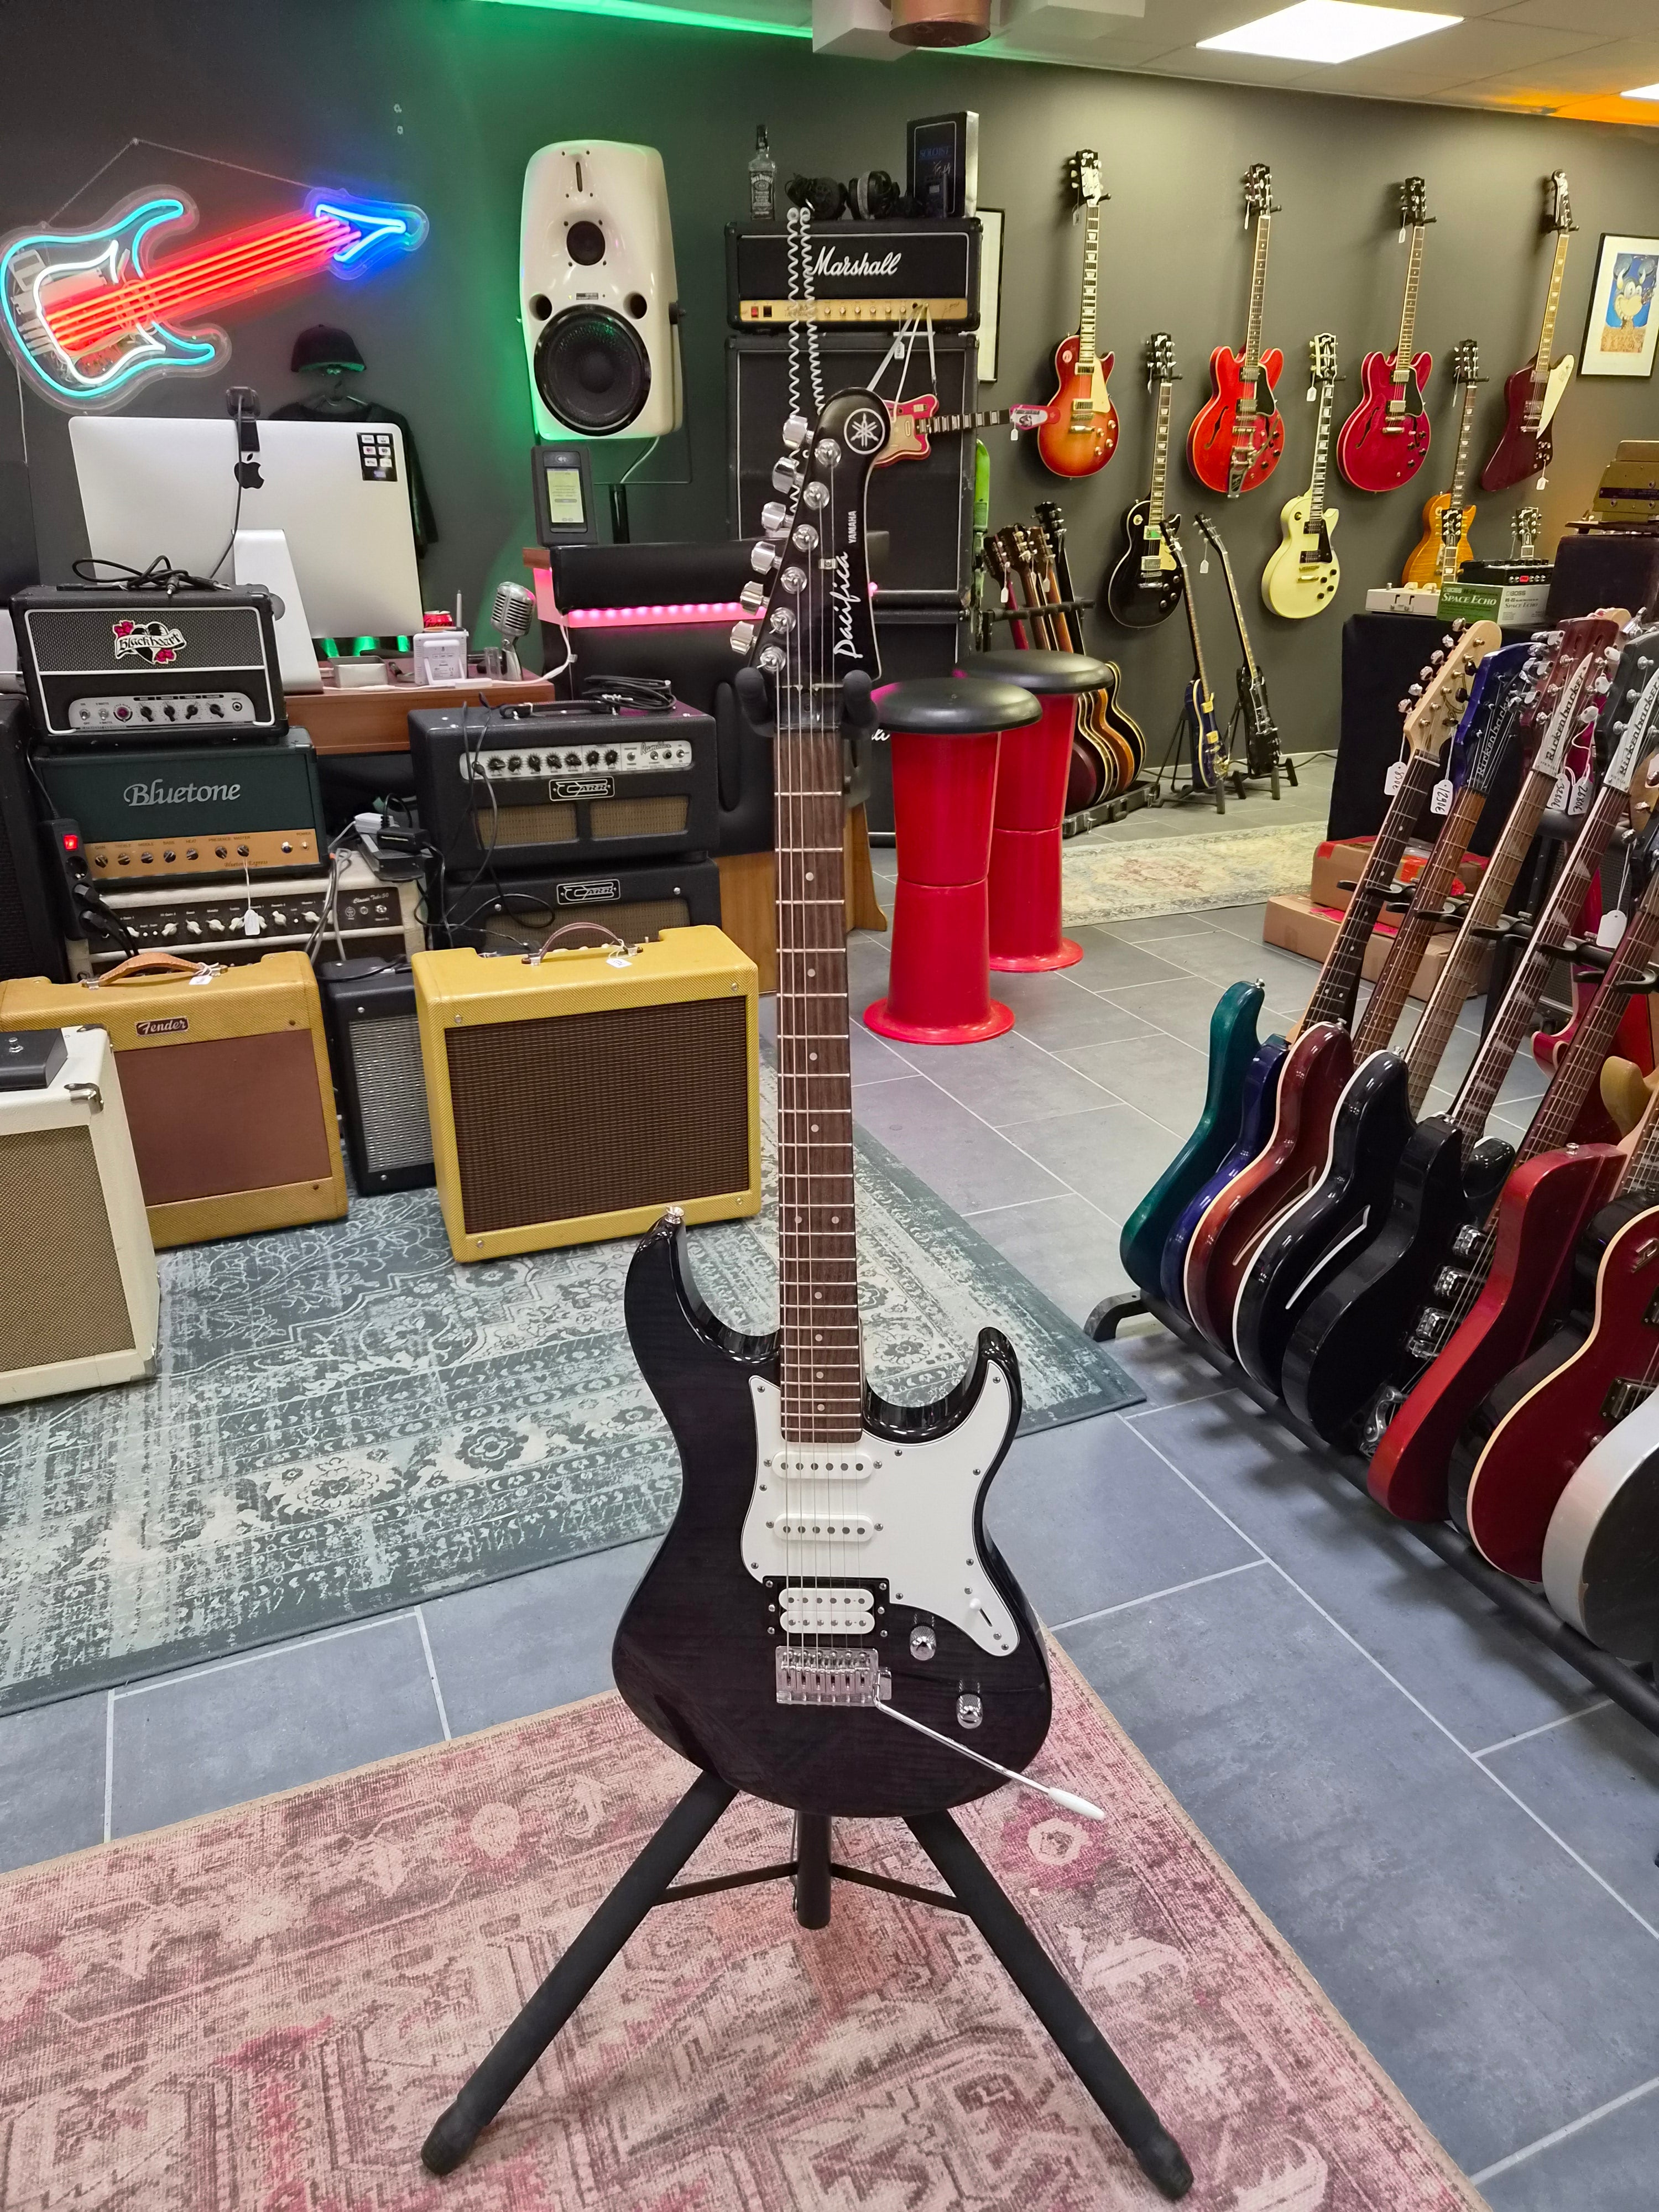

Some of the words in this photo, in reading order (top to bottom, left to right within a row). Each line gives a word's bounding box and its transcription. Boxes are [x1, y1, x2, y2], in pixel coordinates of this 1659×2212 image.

[809, 246, 902, 276] Marshall
[848, 510, 857, 544] YAMAHA
[830, 551, 863, 659] Pacifica
[1442, 593, 1470, 603] SPACE
[1470, 595, 1497, 606] ECHO
[118, 633, 181, 651] Blackheart
[1546, 672, 1583, 762] Rickenbacker
[640, 741, 672, 755] Rambler
[1477, 696, 1510, 778] Rickenbacke
[123, 779, 241, 807] Bluetone
[138, 1019, 186, 1035] Fender
